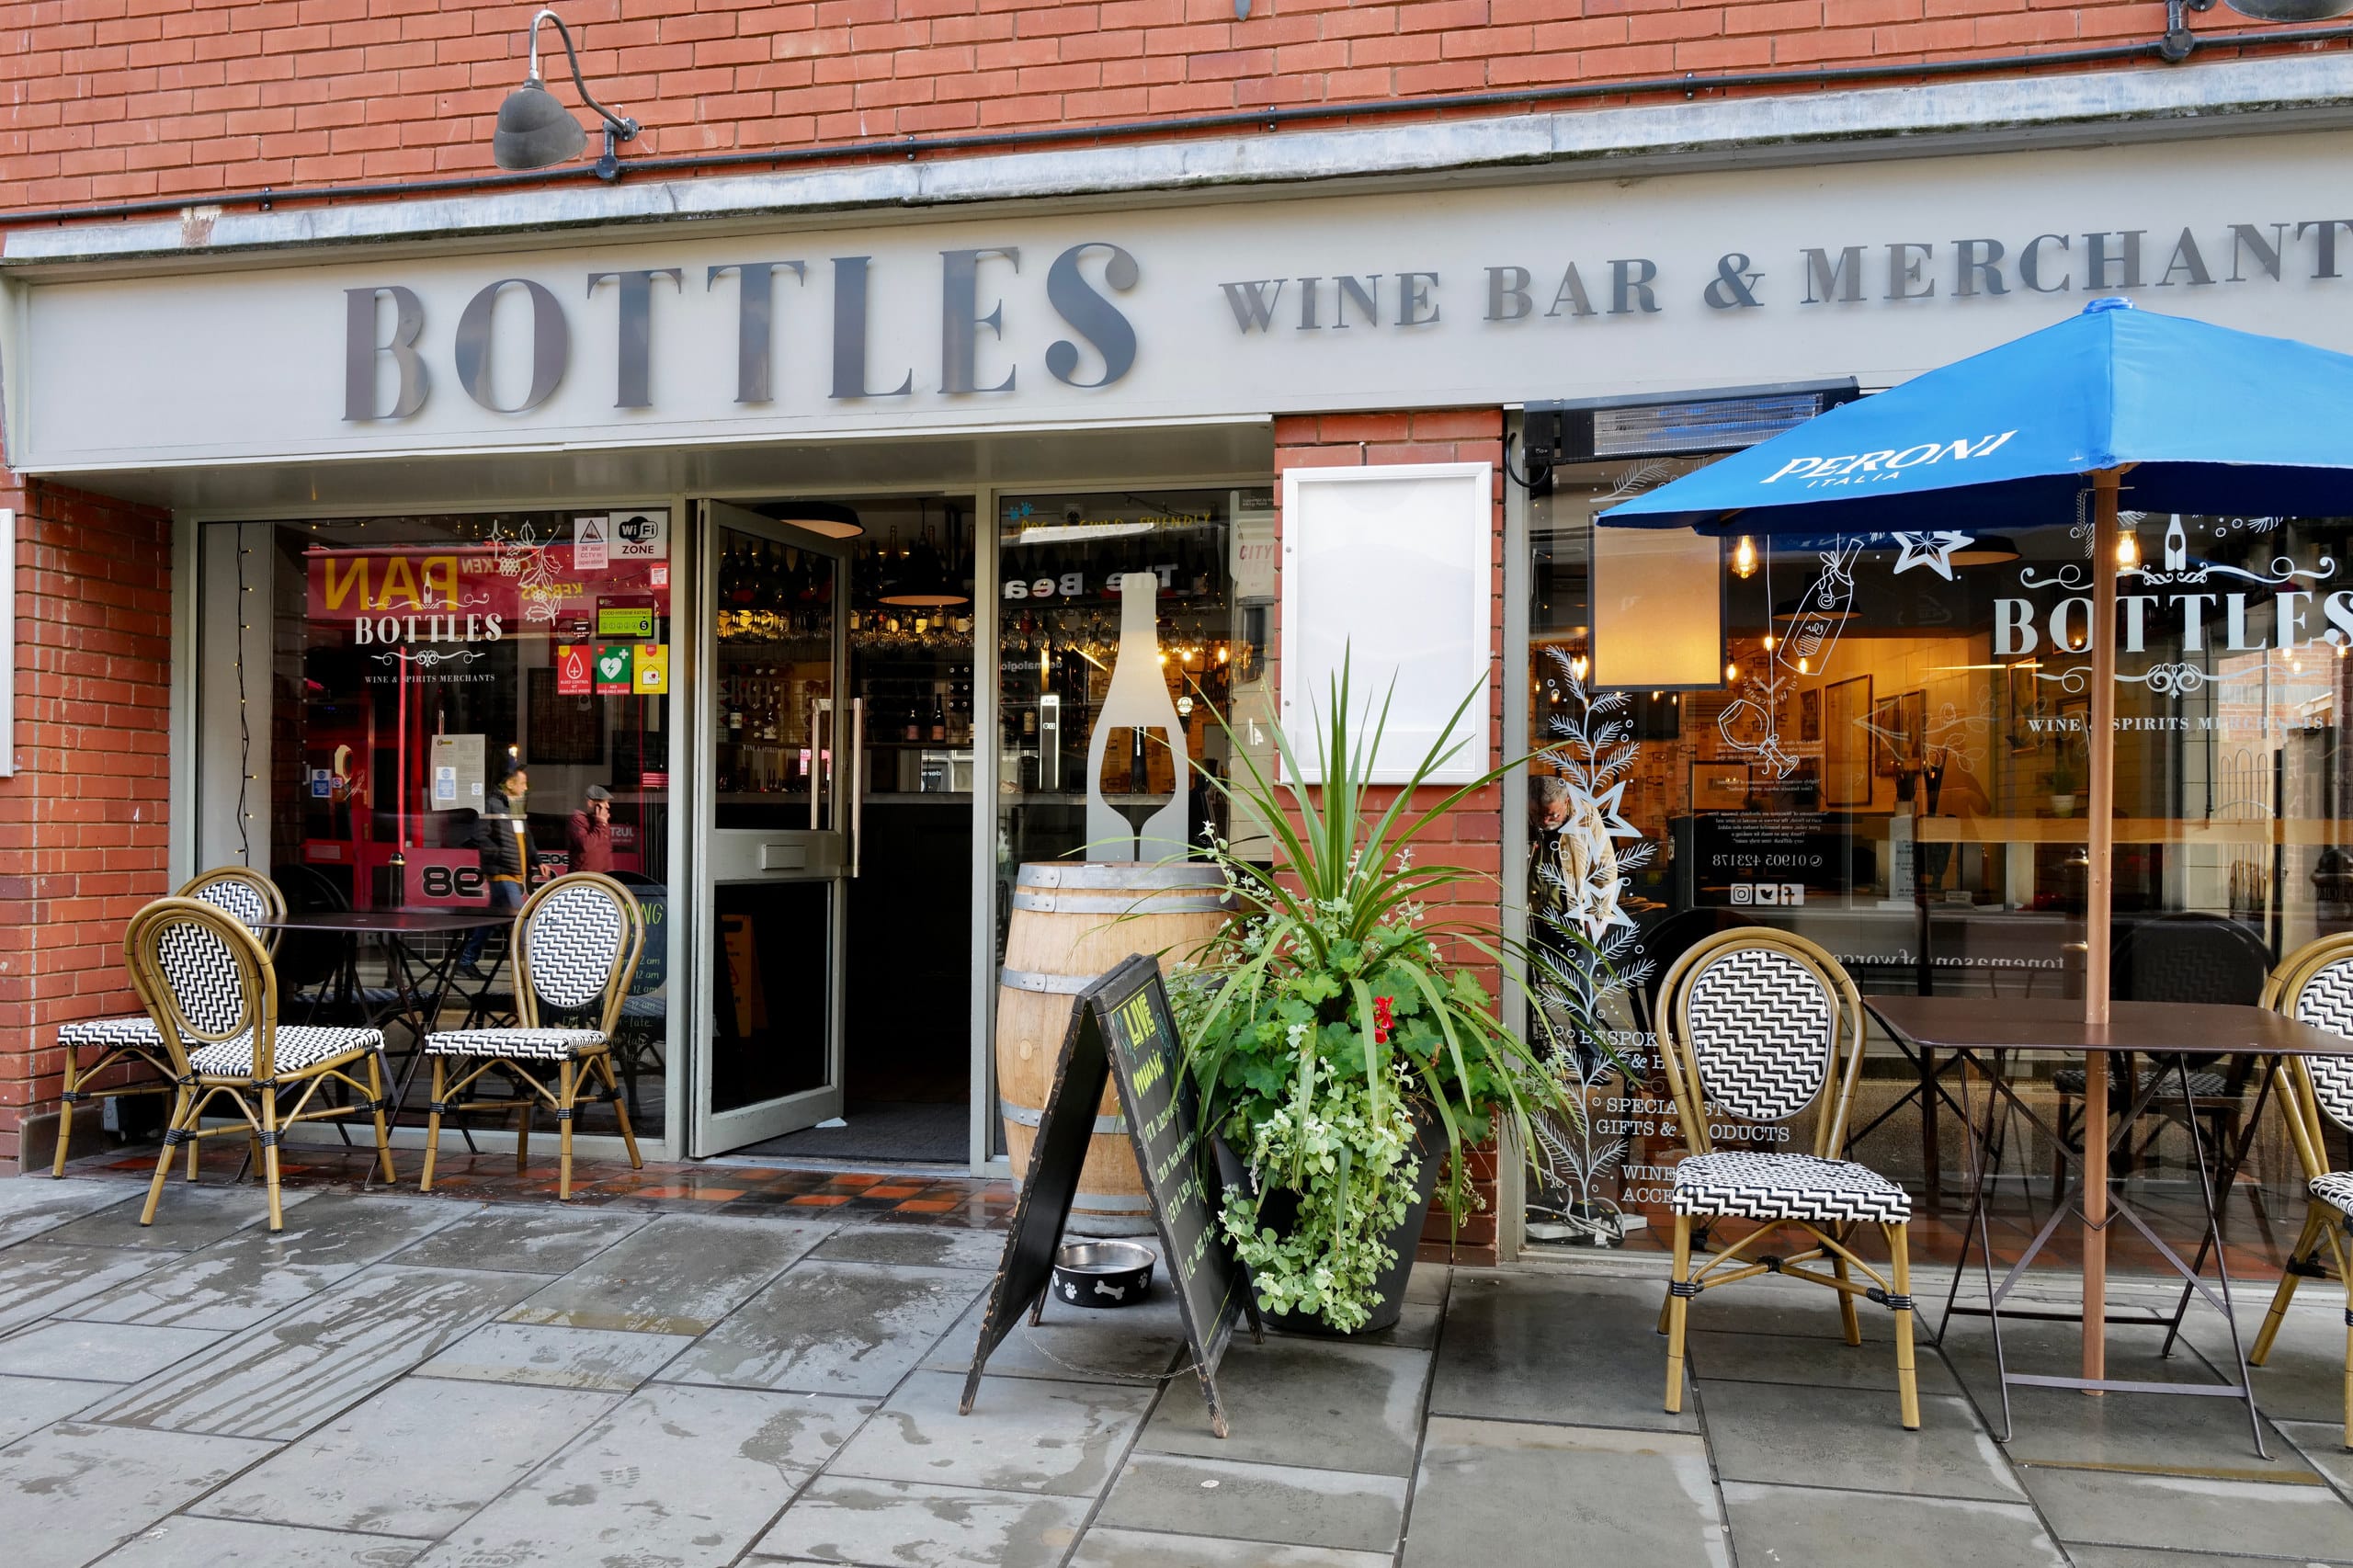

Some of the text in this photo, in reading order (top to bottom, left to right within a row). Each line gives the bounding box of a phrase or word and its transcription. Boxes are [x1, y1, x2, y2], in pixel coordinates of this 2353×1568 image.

[1218, 272, 1440, 335] WINE
[1482, 258, 1663, 322] BAR
[1702, 252, 1766, 310] &
[341, 242, 1140, 422] BOTTLES
[1758, 429, 2020, 484] PERONI
[1806, 471, 1901, 489] ITALIA
[1140, 513, 1211, 530] FRIENDLY
[621, 545, 654, 554] ZONE
[1239, 545, 1273, 560] CITY
[355, 612, 503, 645] BOTTLES
[641, 621, 647, 630] 5
[1993, 590, 2353, 655] BOTTLES
[364, 676, 389, 684] WINE
[402, 675, 437, 683] SPIRITS
[439, 674, 495, 683] MERCHANTS
[2028, 719, 2081, 733] WINE
[2113, 717, 2189, 731] SPIRITS
[1123, 992, 1156, 1051] LIVE
[1579, 1029, 1673, 1047] BESPOK
[1631, 1053, 1648, 1069] &
[1596, 1119, 1655, 1138] GIFTS
[1660, 1122, 1677, 1138] &
